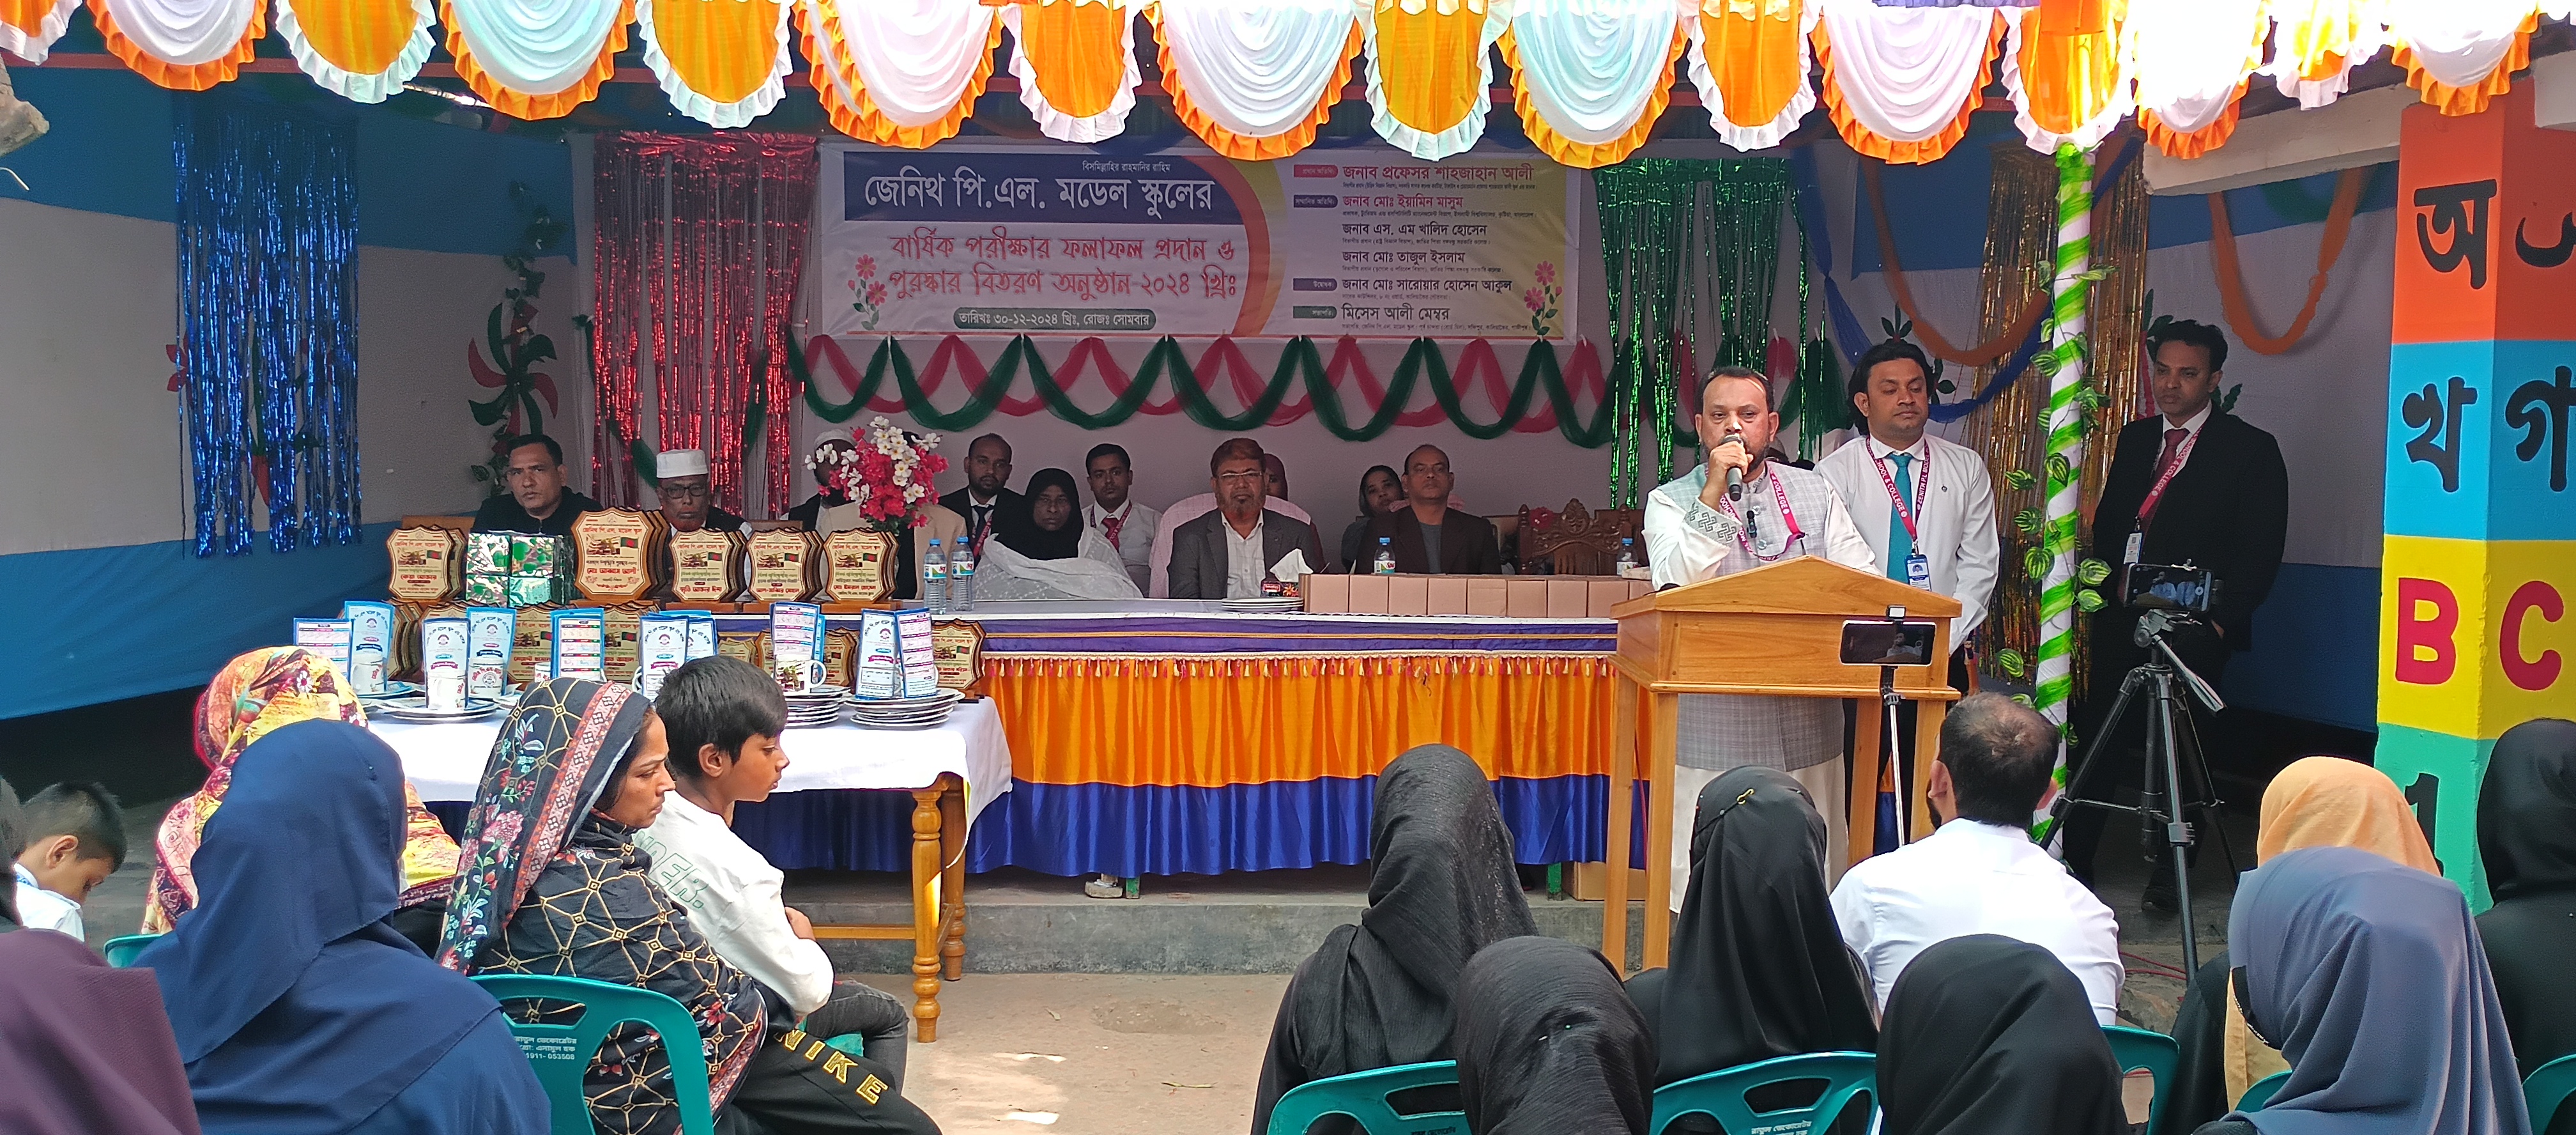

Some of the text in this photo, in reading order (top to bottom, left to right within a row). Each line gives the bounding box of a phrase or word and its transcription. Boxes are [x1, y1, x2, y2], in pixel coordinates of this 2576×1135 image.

[1121, 161, 1150, 172] রাহমানির
[1152, 161, 1170, 173] রাহিম
[1342, 163, 1534, 181] জনাব প্রফেসর শাহজাহান আলী
[864, 165, 946, 208] জেনিথ
[1055, 178, 1132, 210] মডেল
[1138, 180, 1215, 220] স্কুলের
[1343, 193, 1463, 210] জনাব মোঃ ইয়ামিন মাসুম
[890, 225, 1235, 260] বার্ষিক পরীক্ষার ফলাফল প্রদান ও
[1342, 221, 1487, 236] জনাব এস. এম খালিদ হোসেন
[2414, 179, 2497, 290] অ
[1342, 249, 1465, 266] জনাব মোঃ তাজুল ইসলাম
[889, 270, 962, 298] পুরস্কার
[970, 262, 1043, 297] বিতরণ
[1201, 264, 1237, 299] খ্রিঃ
[1342, 279, 1512, 293] জনাব মোঃ সারোয়ার হোসেন আকুল
[958, 310, 990, 325] তারিখঃ
[993, 313, 1058, 325] ৩০-১২-২০২৪
[1084, 313, 1110, 325] রোজঃ
[1113, 313, 1149, 326] সোমবার
[1342, 303, 1450, 321] মিসেস আলী মেম্বর
[2402, 376, 2478, 492] খ
[2505, 365, 2576, 491] গ
[1774, 481, 1788, 509] COLLEGE
[1874, 458, 1888, 479] CHOOL
[1888, 483, 1905, 512] COLLEGE
[2155, 465, 2176, 491] COLLEGE
[2395, 577, 2458, 686] B
[2499, 580, 2564, 690] C
[2405, 773, 2444, 877] 1
[774, 1028, 889, 1106] NIKE
